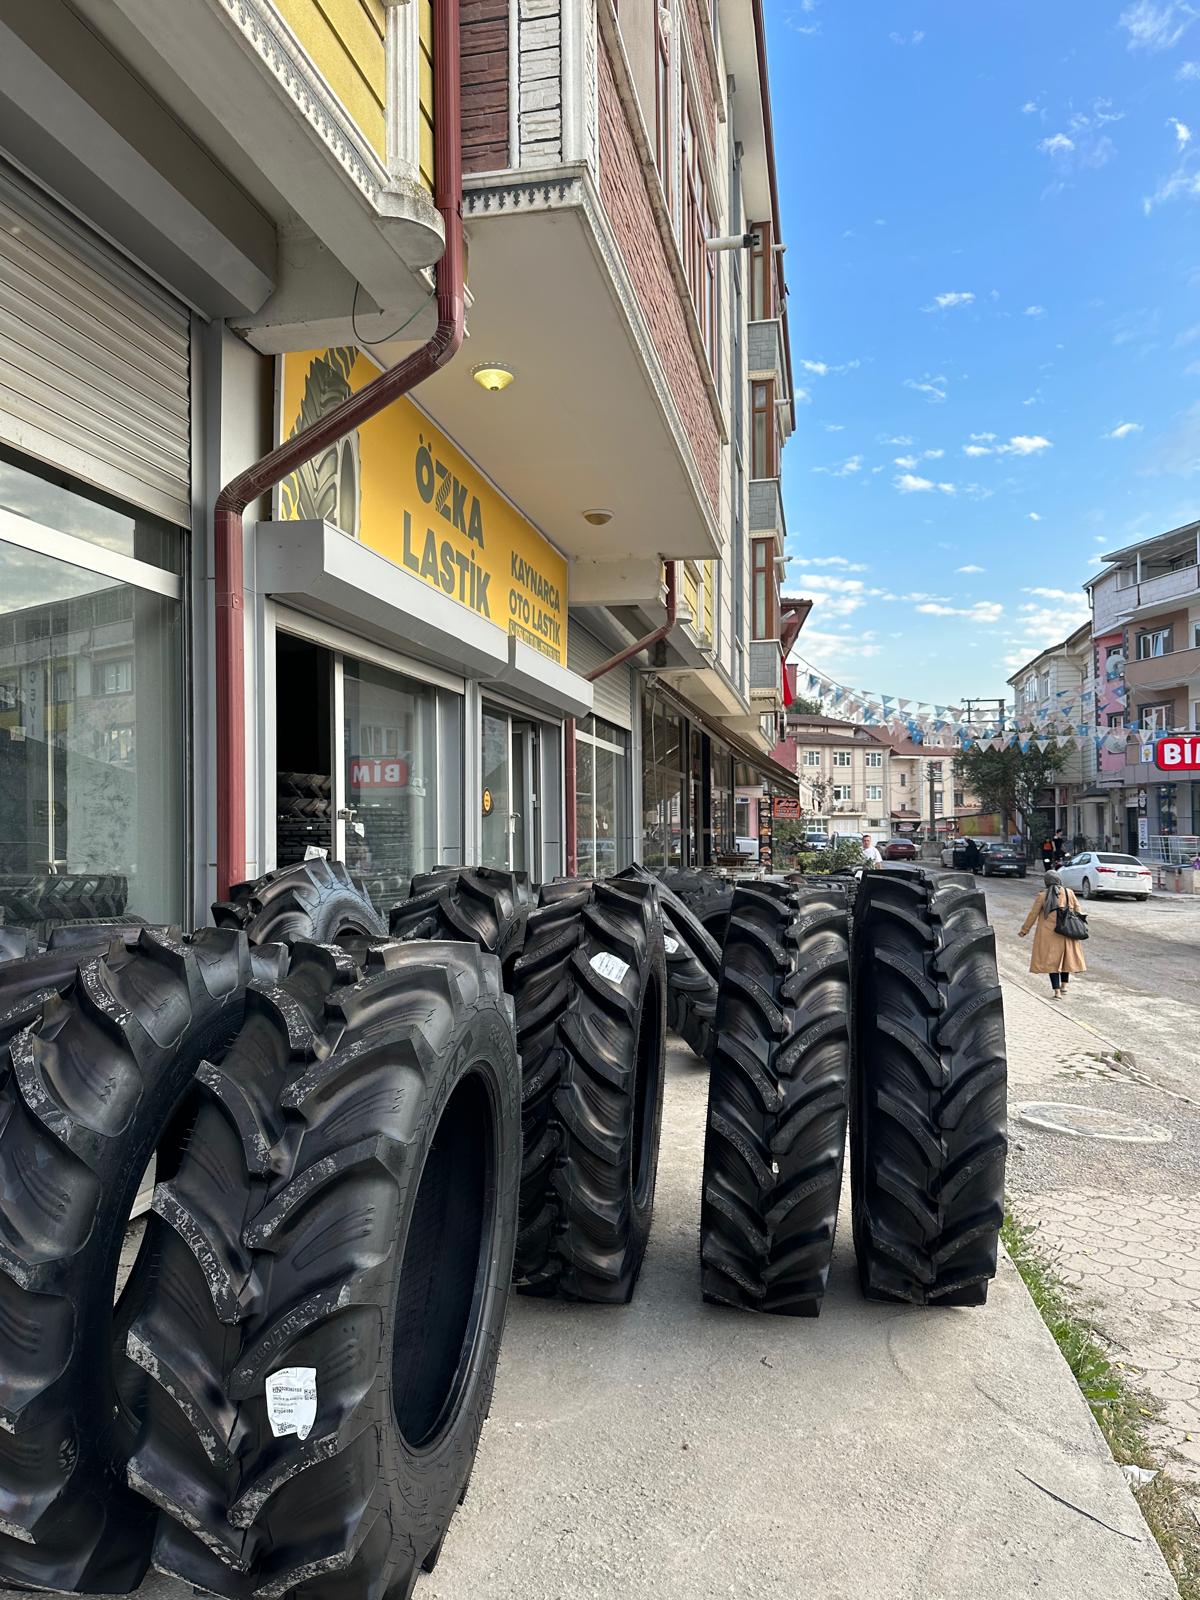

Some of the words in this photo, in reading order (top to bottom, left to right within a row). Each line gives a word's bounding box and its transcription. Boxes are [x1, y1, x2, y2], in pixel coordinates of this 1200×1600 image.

[415, 433, 485, 550] ÖZKA
[403, 510, 491, 618] LASTİK
[511, 550, 560, 613] KAYNARCA
[509, 588, 530, 624] OTO
[532, 604, 560, 646] LASTİK
